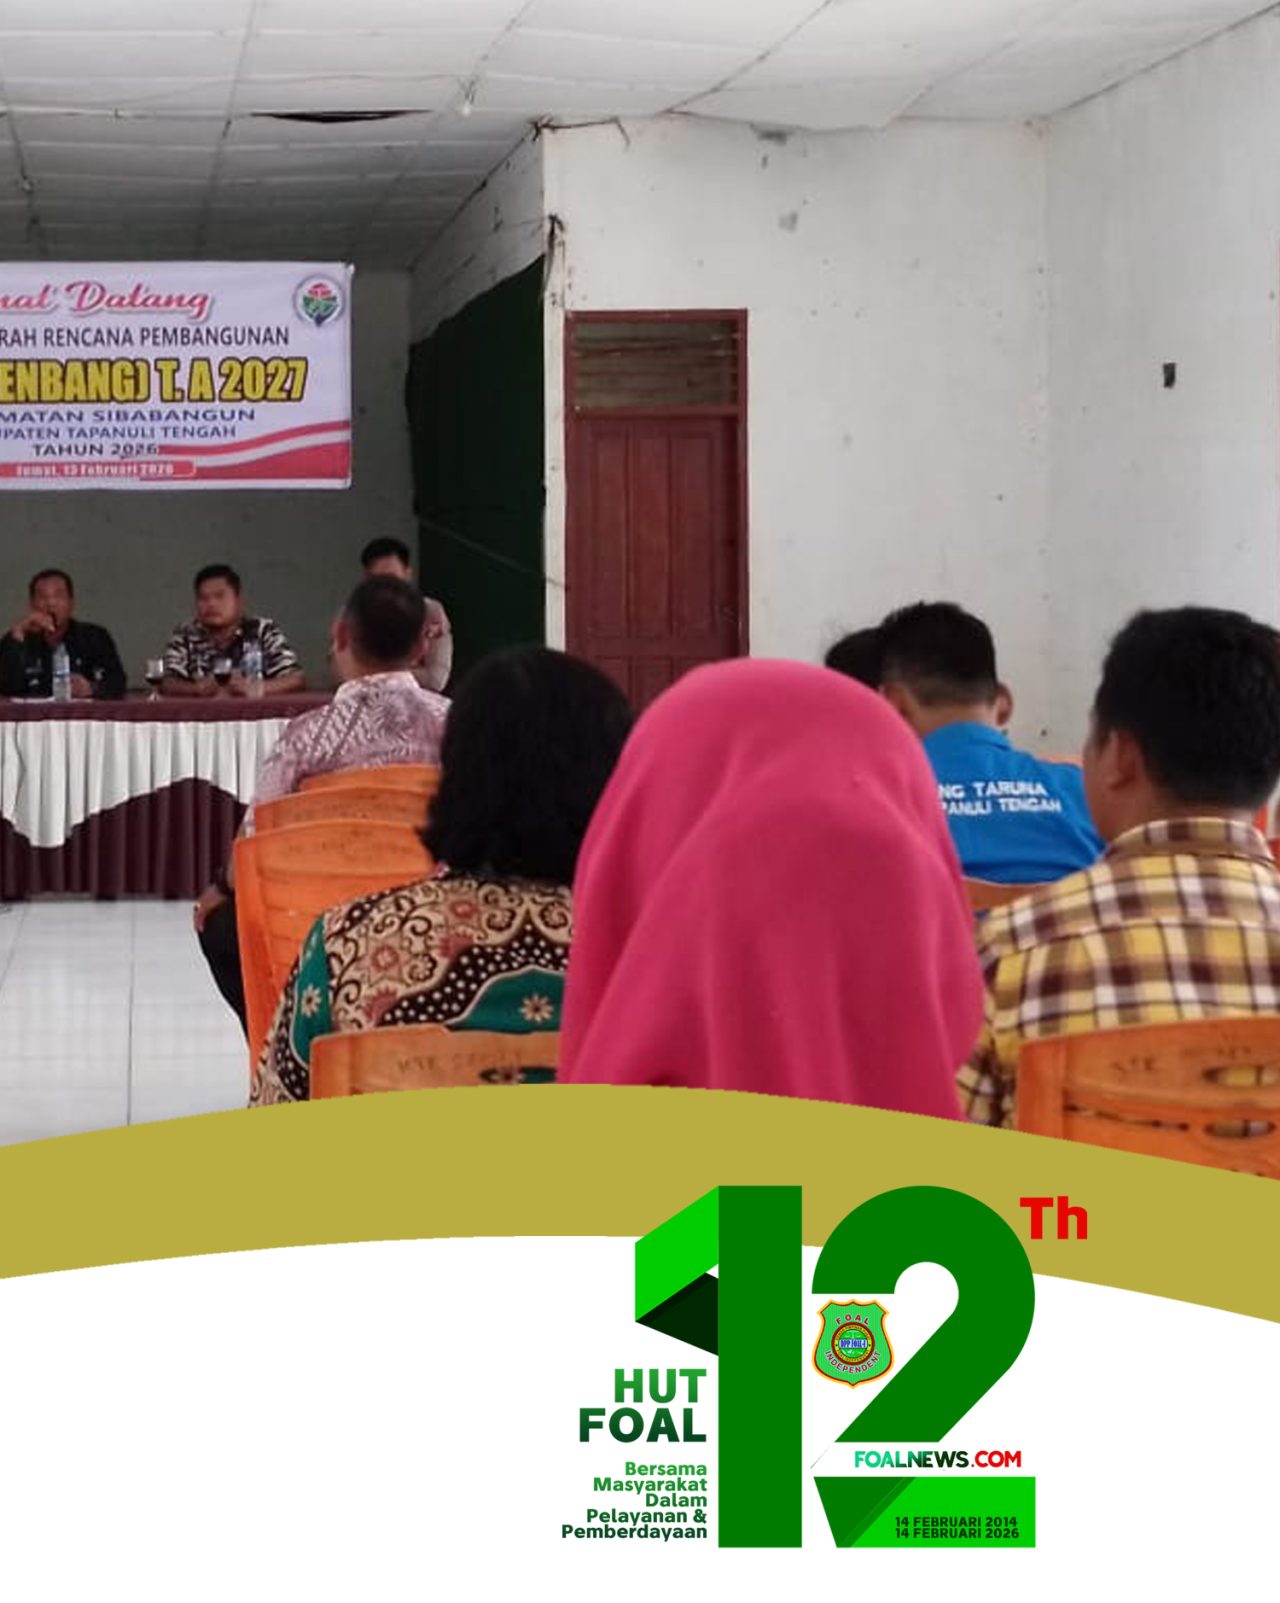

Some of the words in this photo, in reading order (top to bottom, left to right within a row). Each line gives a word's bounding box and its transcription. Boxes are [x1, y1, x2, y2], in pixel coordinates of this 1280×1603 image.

[65, 281, 211, 321] Datang
[43, 326, 134, 348] RENCANA
[140, 325, 289, 347] PEMBANGUNAN
[218, 356, 308, 403] 2027
[92, 408, 255, 422] SIBABANGUN
[66, 426, 155, 439] TAPANULI
[160, 425, 237, 438] TENGAH
[32, 443, 104, 457] TAHUN
[110, 443, 158, 456] 2026
[80, 463, 138, 477] Februari
[972, 780, 1049, 798] TARUNA
[997, 797, 1062, 812] TENGAH
